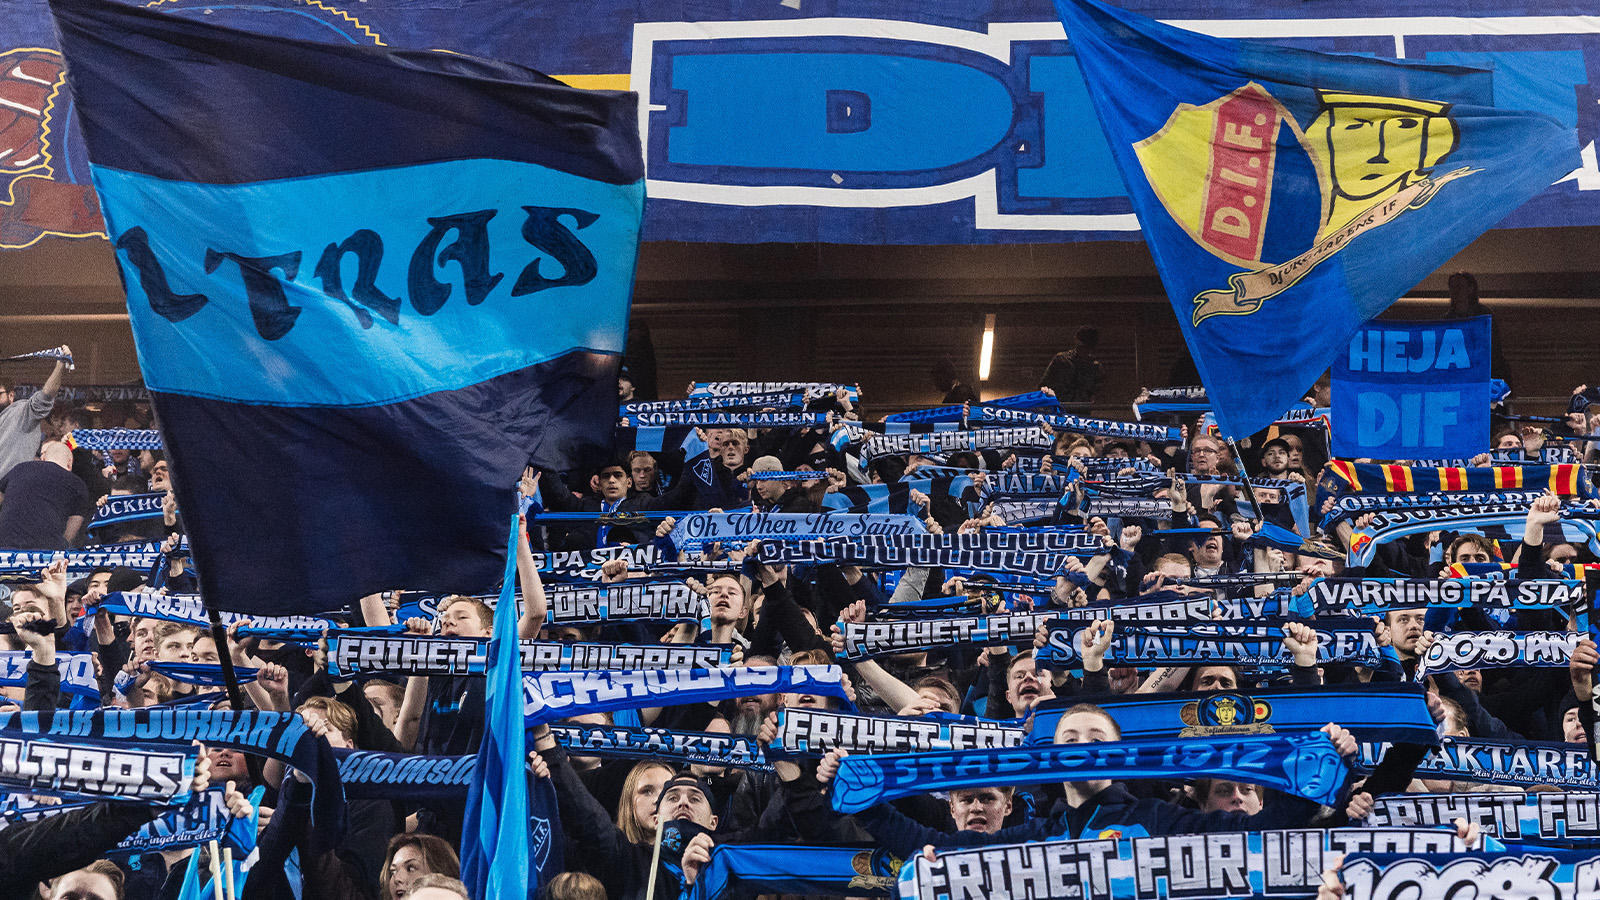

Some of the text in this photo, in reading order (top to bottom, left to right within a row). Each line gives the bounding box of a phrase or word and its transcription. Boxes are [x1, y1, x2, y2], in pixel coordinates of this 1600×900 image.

[1210, 112, 1268, 240] D.I.F.
[1382, 199, 1398, 217] IF
[114, 204, 601, 342] LTRAS
[1349, 328, 1471, 374] HEJA
[974, 427, 1051, 448] ULTRAS
[1357, 391, 1461, 448] DIF
[688, 514, 720, 537] Oh
[727, 513, 798, 535] When
[806, 513, 846, 534] The
[608, 583, 702, 617] ULTRA
[1471, 578, 1510, 602] PÅ
[847, 618, 977, 650] FRIHET
[1424, 632, 1518, 667] 00%
[340, 639, 475, 670] FRIHET
[523, 666, 778, 716] OCKHOLMS
[786, 710, 936, 752] FRIHET
[894, 743, 1273, 784] STADION 1912
[918, 840, 1114, 900] FRIHET
